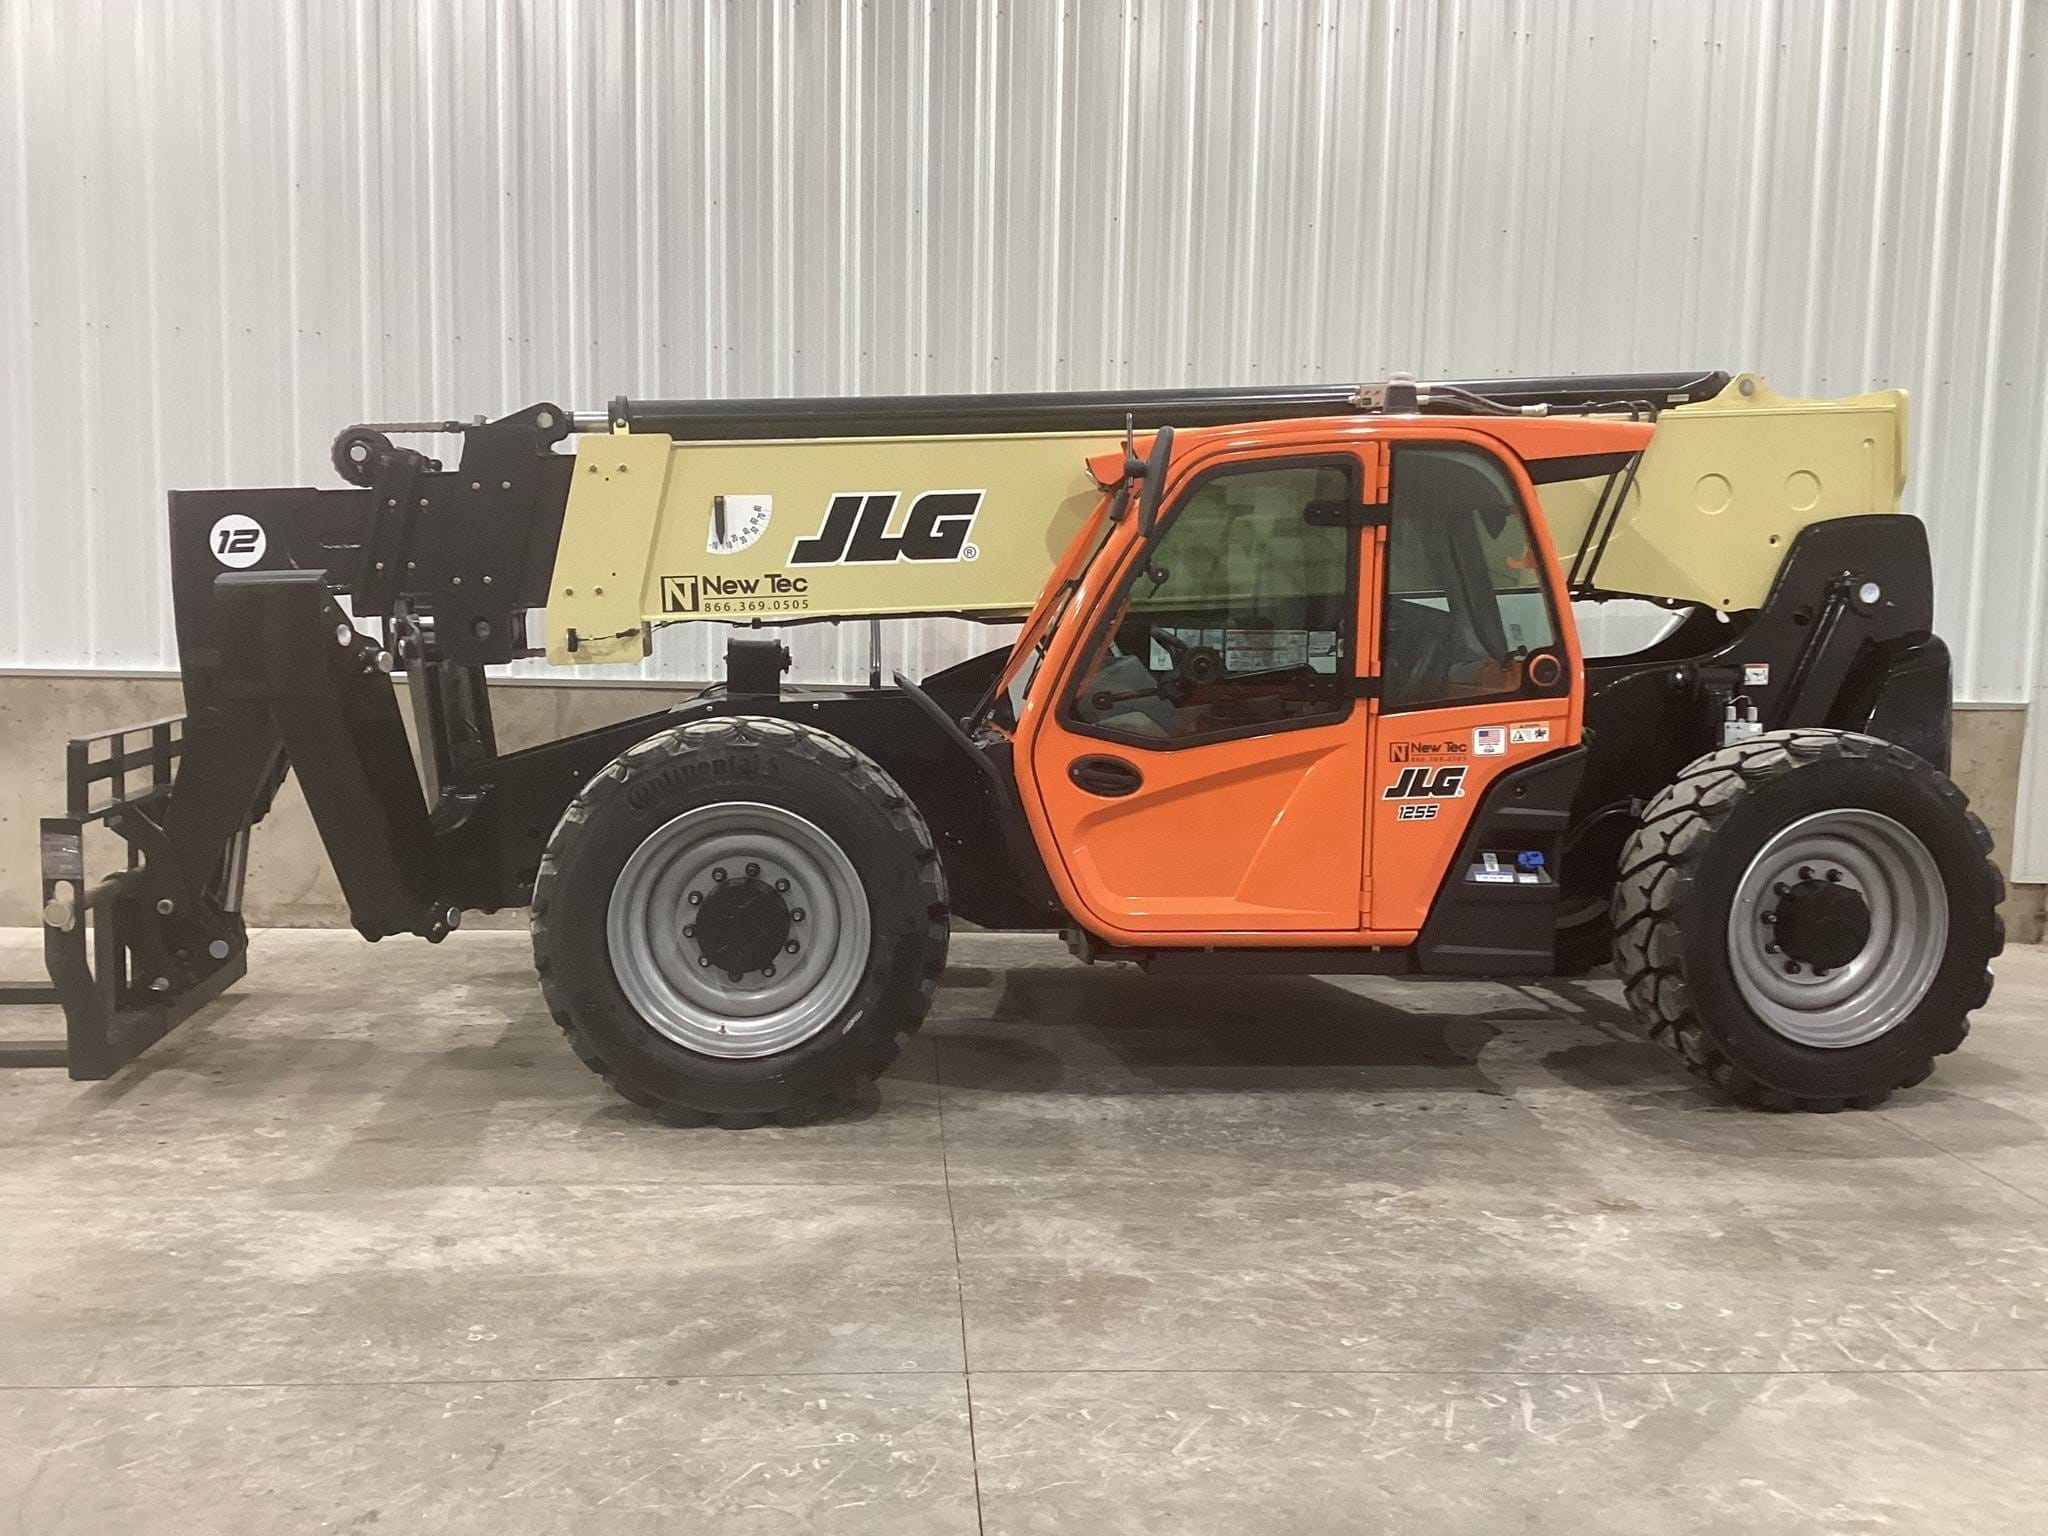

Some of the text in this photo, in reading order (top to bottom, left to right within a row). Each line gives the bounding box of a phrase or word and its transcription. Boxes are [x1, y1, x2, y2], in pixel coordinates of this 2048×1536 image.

[217, 528, 260, 554] 12
[702, 573, 808, 596] New Tec
[704, 599, 809, 612] 866.369.0505
[1410, 741, 1467, 753] New Tec
[1383, 767, 1467, 799] JLG
[1398, 804, 1439, 819] 1255
